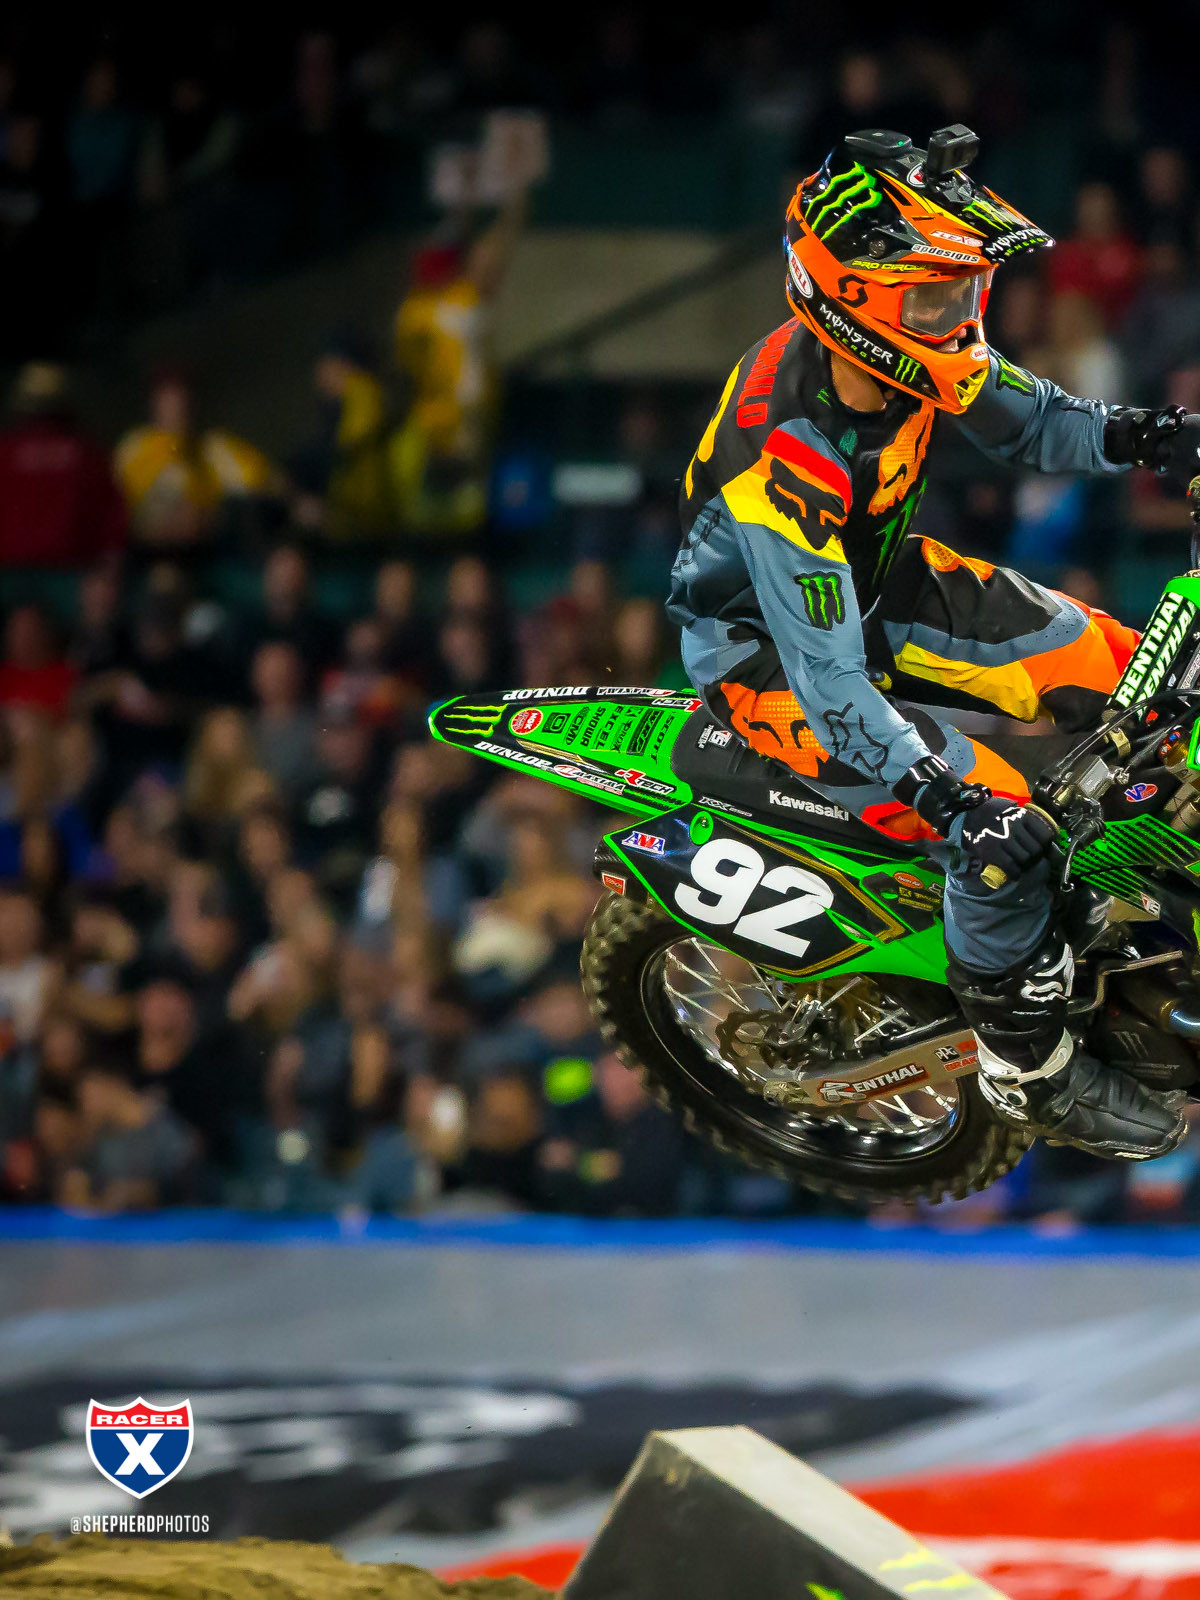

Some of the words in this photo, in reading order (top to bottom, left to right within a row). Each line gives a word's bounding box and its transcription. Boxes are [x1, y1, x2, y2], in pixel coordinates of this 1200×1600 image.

[790, 256, 808, 292] BELL
[852, 260, 880, 270] PRO
[819, 303, 894, 365] MONSTER
[825, 323, 877, 364] ENERGY
[502, 687, 592, 701] DUNLOP
[525, 711, 538, 730] NGK
[580, 707, 605, 747] SHOWA
[599, 706, 622, 750] EXCEL
[474, 740, 553, 769] DUNLOP
[651, 714, 675, 765] SCOTT
[769, 790, 849, 822] Kawasaki
[622, 831, 666, 854] AMA
[674, 838, 835, 958] 92
[945, 1055, 978, 1072] BRAK
[819, 1064, 926, 1102] RENTHAL
